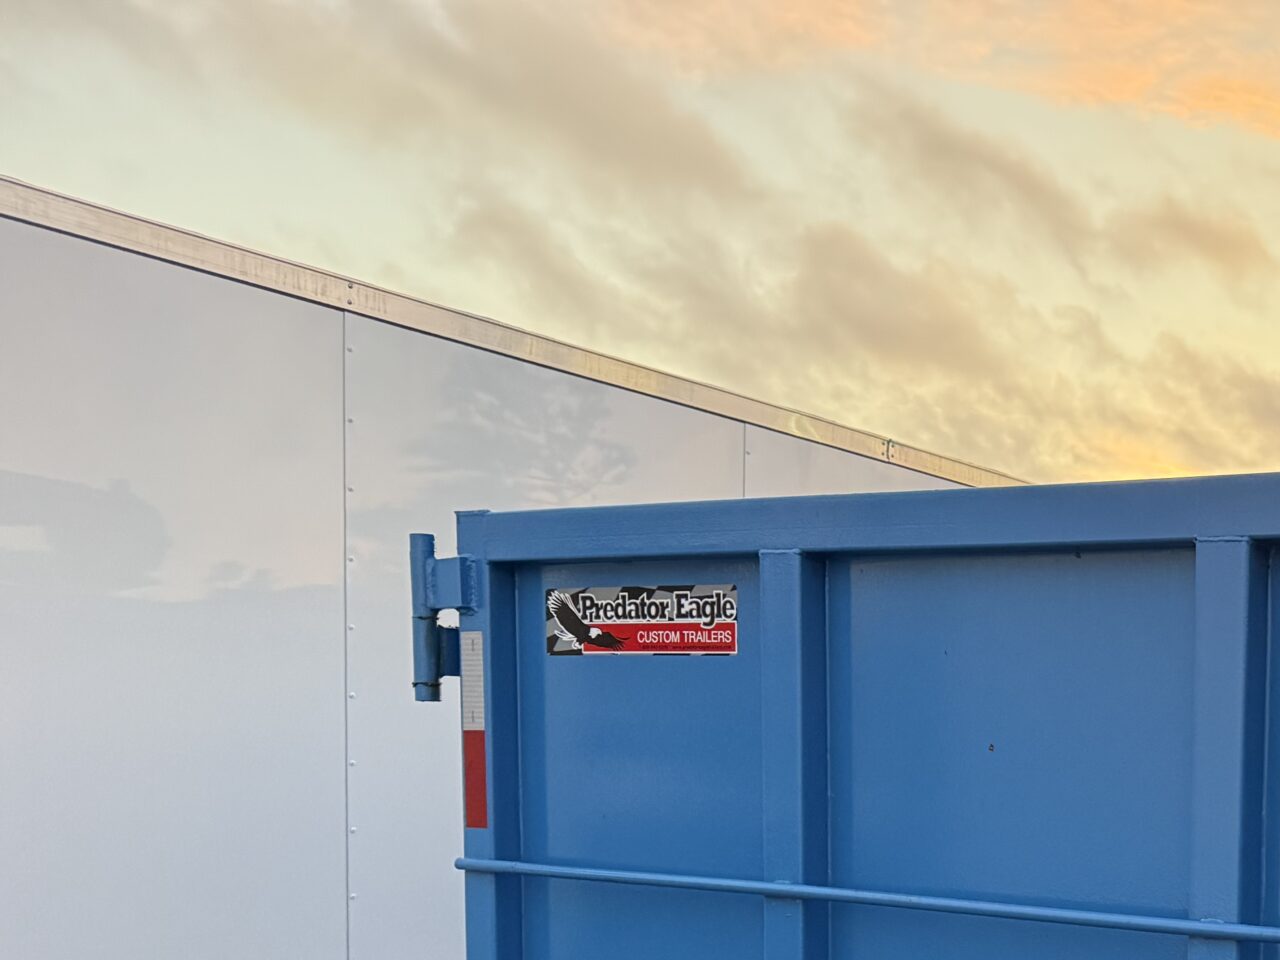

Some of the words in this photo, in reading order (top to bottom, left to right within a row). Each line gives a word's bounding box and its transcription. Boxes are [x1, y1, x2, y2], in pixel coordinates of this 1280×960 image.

[579, 593, 670, 622] Predator
[674, 591, 736, 628] Eagle
[637, 630, 680, 643] CUSTOM
[682, 630, 732, 643] TRAILERS
